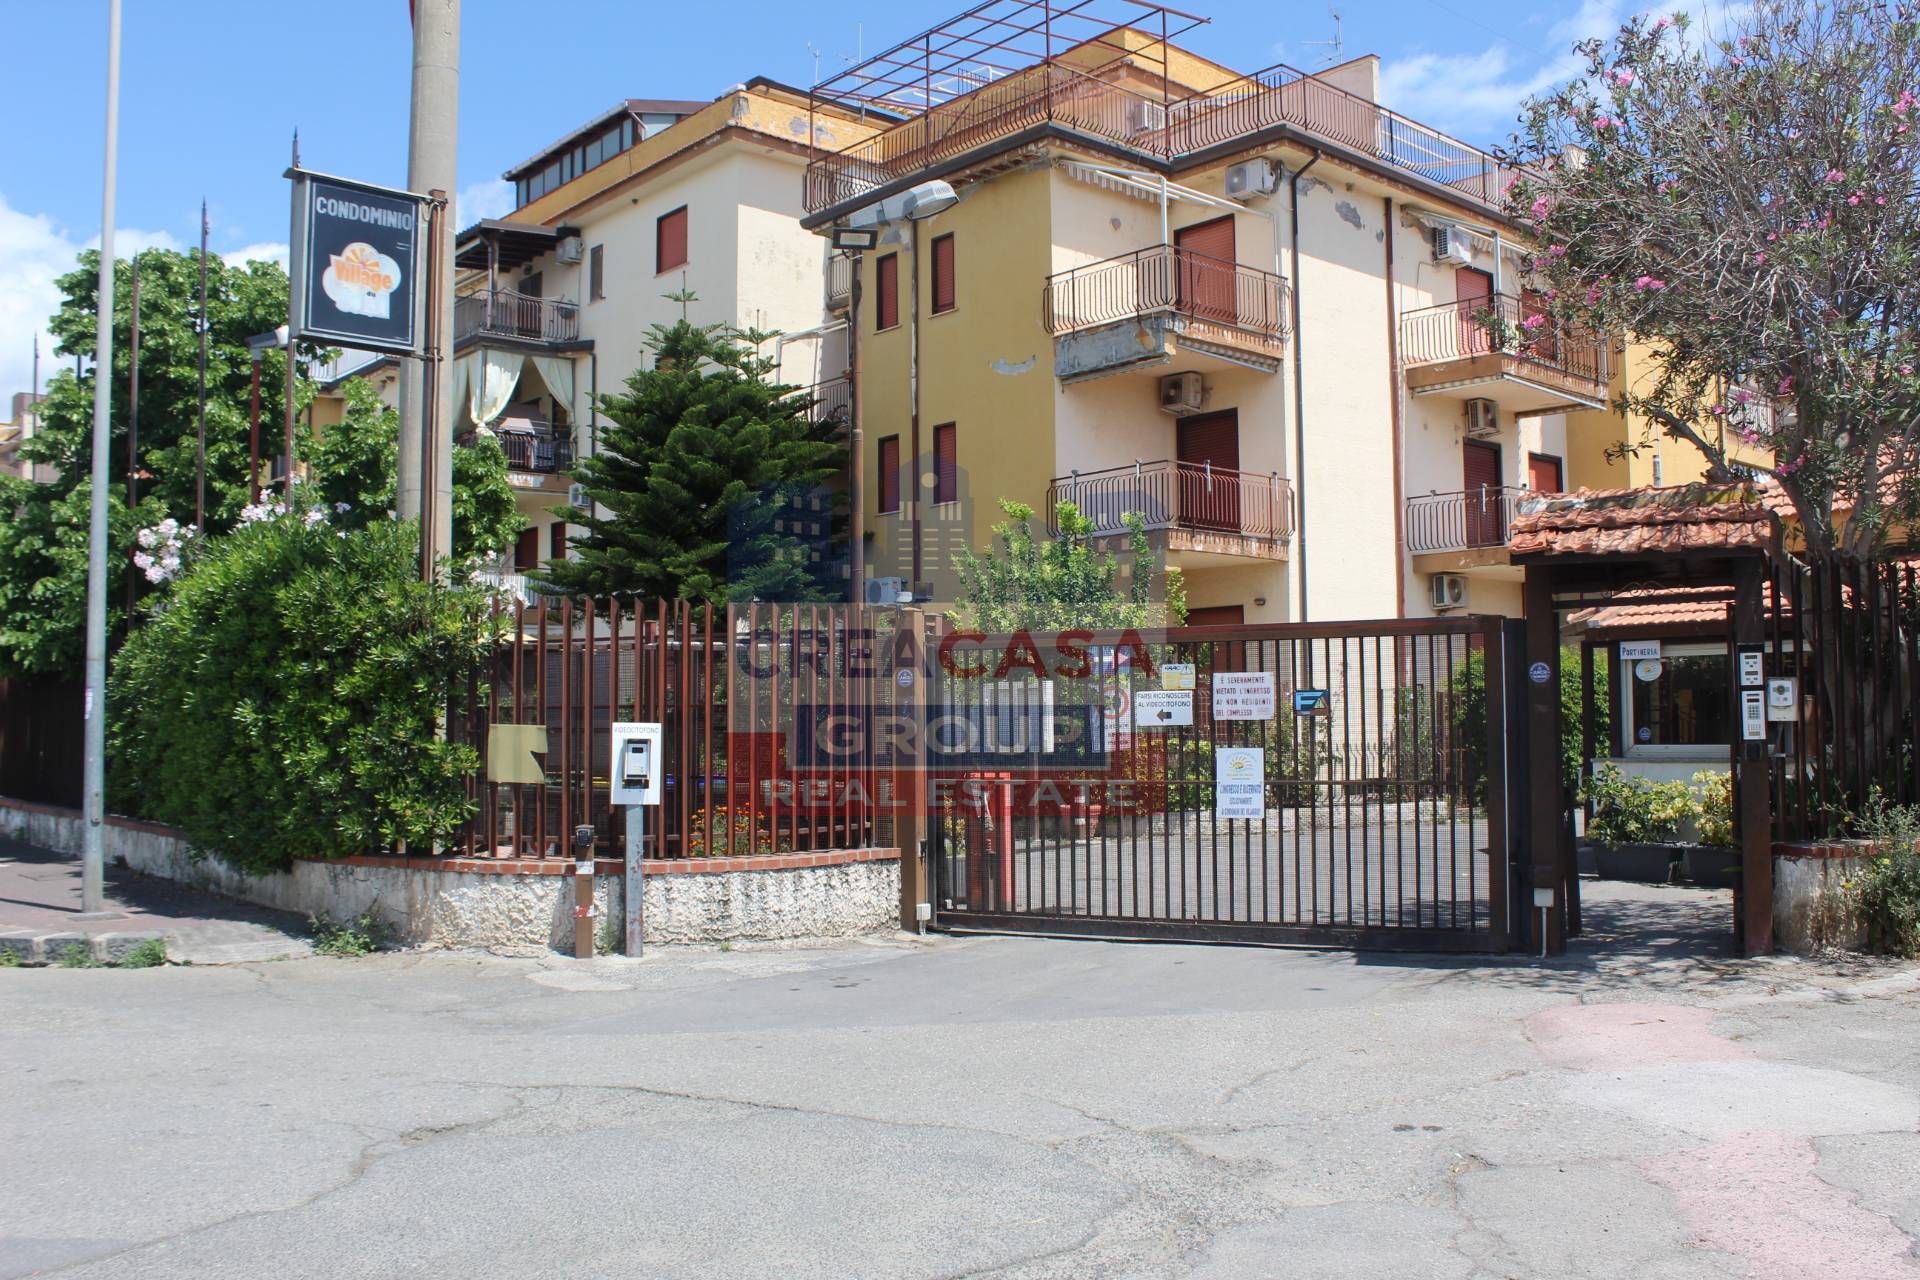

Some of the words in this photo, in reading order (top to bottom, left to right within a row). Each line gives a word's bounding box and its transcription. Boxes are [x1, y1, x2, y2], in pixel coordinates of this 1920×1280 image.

[316, 196, 412, 230] CONDOMINIO
[335, 259, 392, 292] Village
[1227, 676, 1265, 684] SEVERAMENTE
[1216, 687, 1237, 695] VIETATO
[1216, 709, 1224, 717] DEL
[1226, 709, 1253, 717] COMPLESSO
[614, 726, 660, 734] VIDEOCITOFONO
